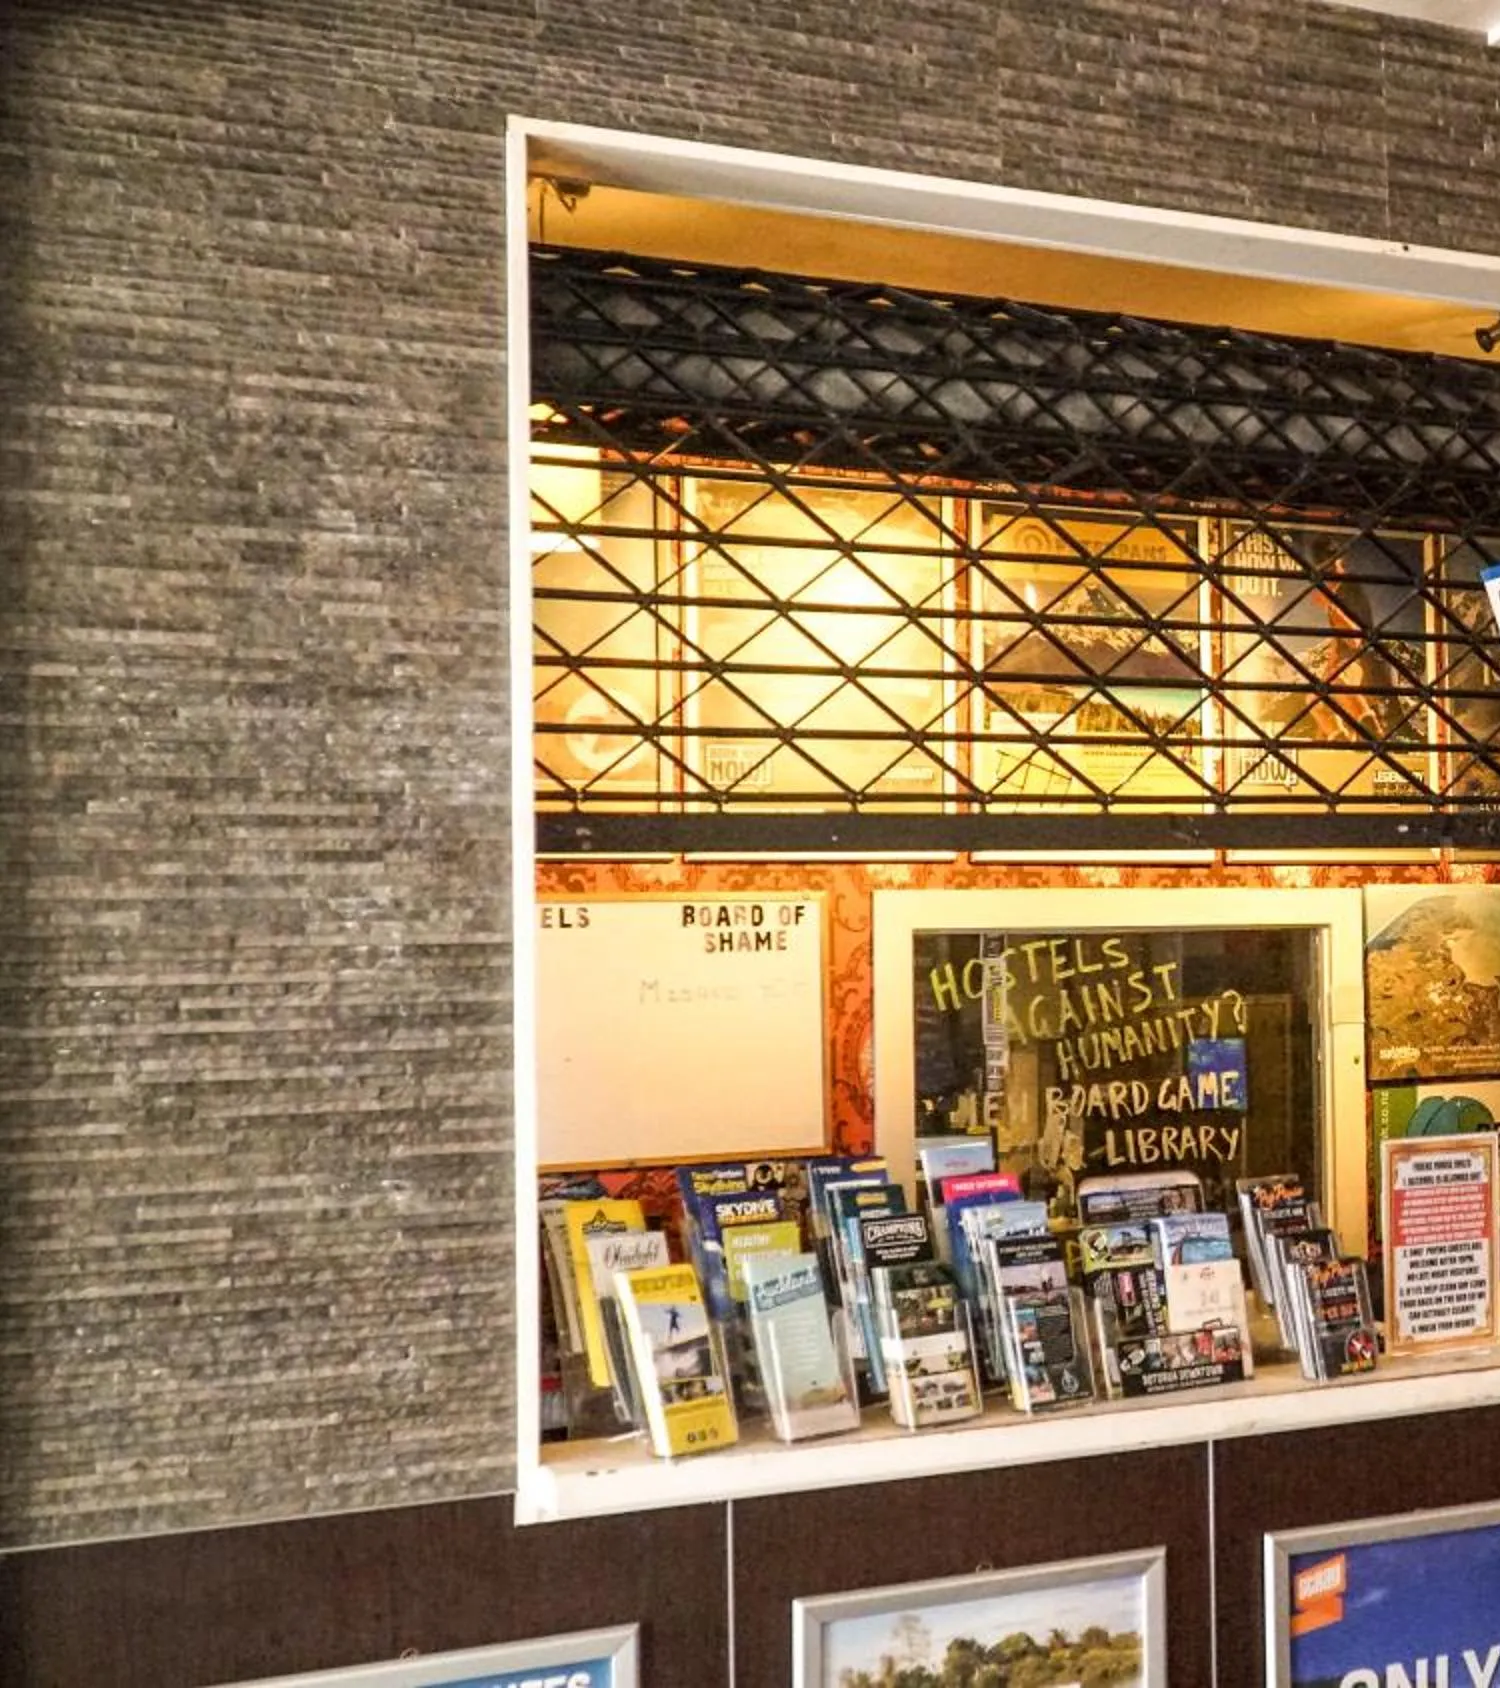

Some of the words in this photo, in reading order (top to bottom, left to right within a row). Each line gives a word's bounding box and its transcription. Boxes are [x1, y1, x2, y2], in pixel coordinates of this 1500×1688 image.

[540, 907, 590, 929] ELS
[682, 905, 763, 928] BOARD
[779, 905, 806, 926] OF
[704, 931, 787, 953] SHAME
[929, 937, 1130, 1012] HOSTELS
[1002, 962, 1178, 1045] AGAINST
[1056, 988, 1248, 1080] HUMANITY?
[1044, 1080, 1149, 1120] BOARD
[1157, 1070, 1240, 1112] GAME
[1105, 1127, 1240, 1166] LIBRARY
[715, 1198, 775, 1217] SKYDIVE
